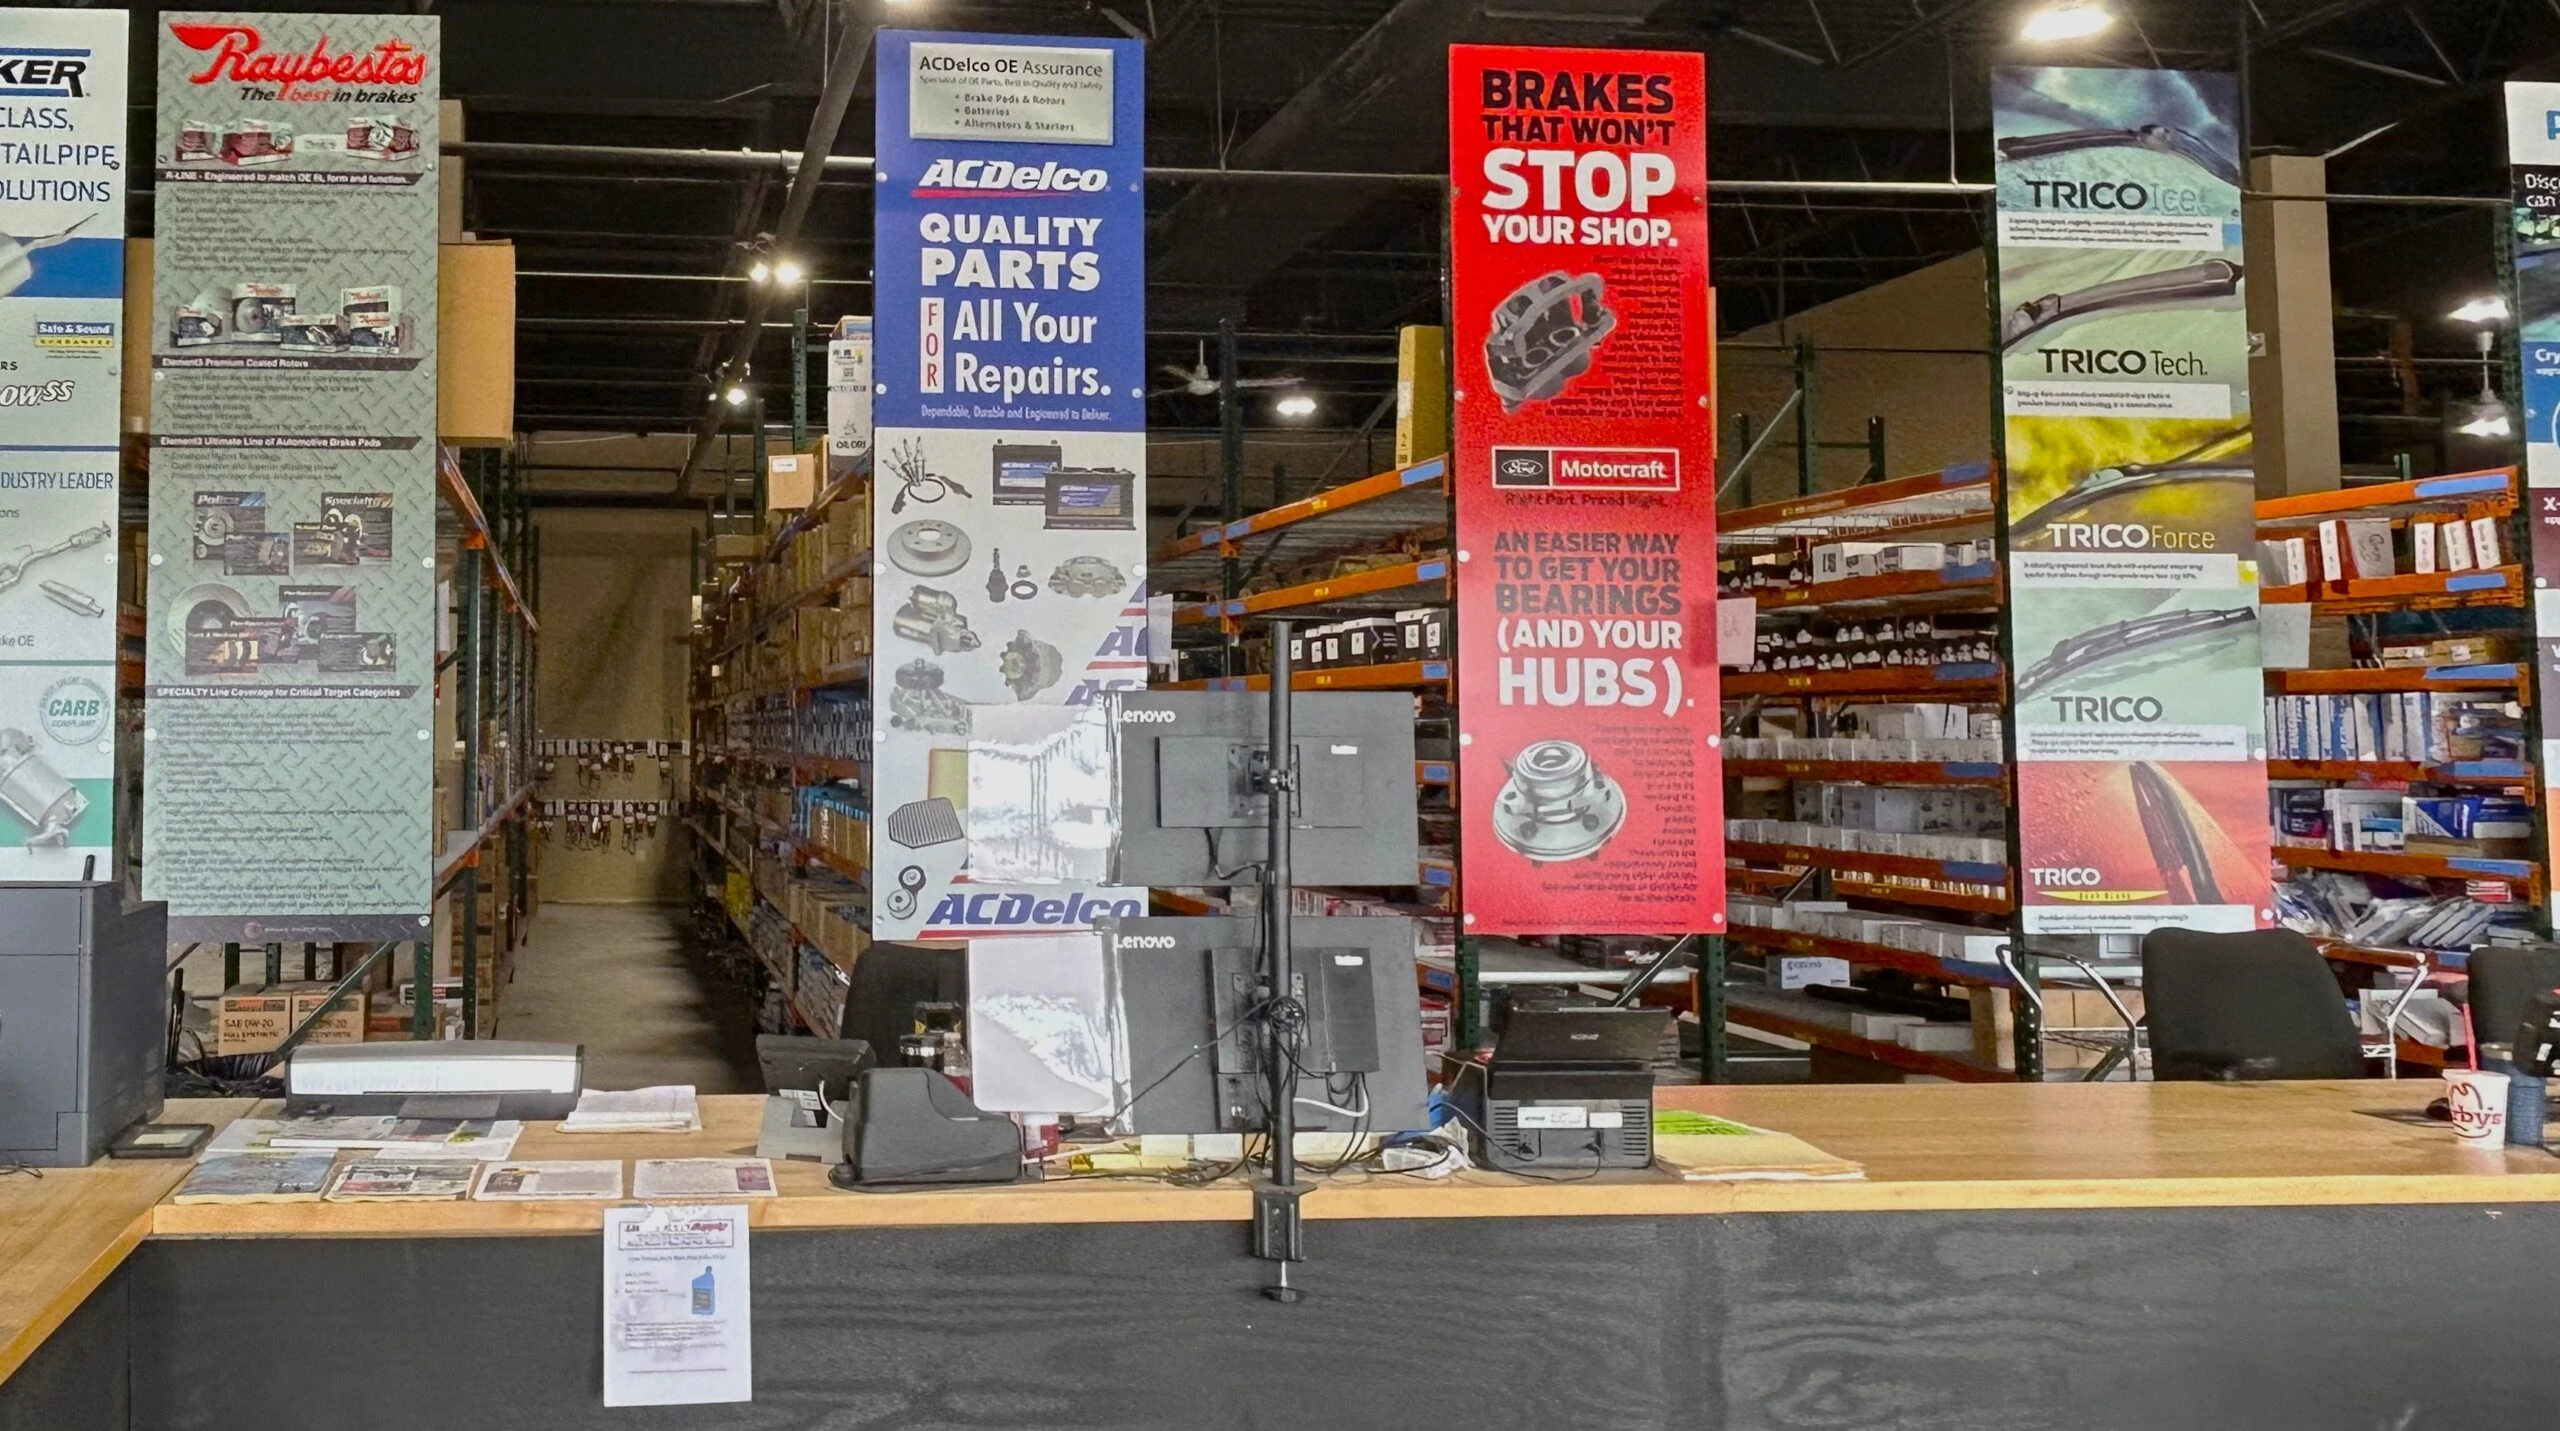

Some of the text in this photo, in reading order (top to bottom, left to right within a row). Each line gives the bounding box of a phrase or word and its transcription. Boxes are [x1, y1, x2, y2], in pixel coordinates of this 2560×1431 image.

[168, 22, 428, 92] Raybestos
[919, 57, 1103, 78] ACDelco OE Assurance
[240, 87, 276, 101] The
[333, 87, 352, 101] in
[354, 87, 417, 104] brakes
[964, 93, 993, 103] Brake
[1481, 68, 1675, 115] BRAKES
[964, 106, 1010, 117] Batteries
[1480, 114, 1675, 146] THAT WON'T
[1, 142, 116, 167] TAILPIPE
[204, 171, 256, 183] Engineered
[257, 172, 267, 182] to
[268, 173, 296, 184] match
[327, 174, 348, 184] form
[350, 174, 367, 184] and
[918, 159, 1109, 192] ACDelco
[1481, 147, 1676, 213] STOP
[2524, 173, 2560, 191] Disc
[2025, 179, 2148, 210] TRICO
[2526, 195, 2556, 208] can
[919, 212, 1103, 247] QUALITY
[1481, 214, 1679, 248] YOUR SHOP.
[921, 247, 1101, 292] PARTS
[952, 298, 1098, 344] All Your
[926, 302, 939, 388] FOR
[204, 359, 244, 368] Premium
[246, 359, 278, 368] Coated
[2037, 348, 2147, 375] TRICO
[955, 351, 1112, 404] Repairs.
[921, 404, 971, 420] Dependable,
[973, 405, 1005, 419] Durable
[1007, 406, 1023, 419] and
[1025, 407, 1069, 422] Engineered
[204, 437, 243, 447] Ultimate
[243, 437, 263, 447] Line
[264, 437, 276, 447] of
[276, 437, 328, 448] Automotive
[60, 472, 114, 489] LEADER
[1560, 459, 1667, 479] Motorcraft
[1494, 532, 1680, 554] AN EASIER WAY
[2047, 523, 2215, 550] TRICO Force
[1493, 556, 1681, 583] TO GET YOUR
[1495, 583, 1682, 616] BEARINGS
[17, 635, 36, 647] OE
[1497, 617, 1683, 653] (AND YOUR
[156, 688, 401, 699] SPECIALTY Line Coverage for Critical Target Categories
[1498, 655, 1695, 718] HUBS).
[49, 699, 100, 716] CARB
[2050, 696, 2163, 722] TRICO
[2029, 867, 2102, 886] TRICO
[926, 892, 1142, 924] ACDelco
[1113, 933, 1176, 949] Lenovo
